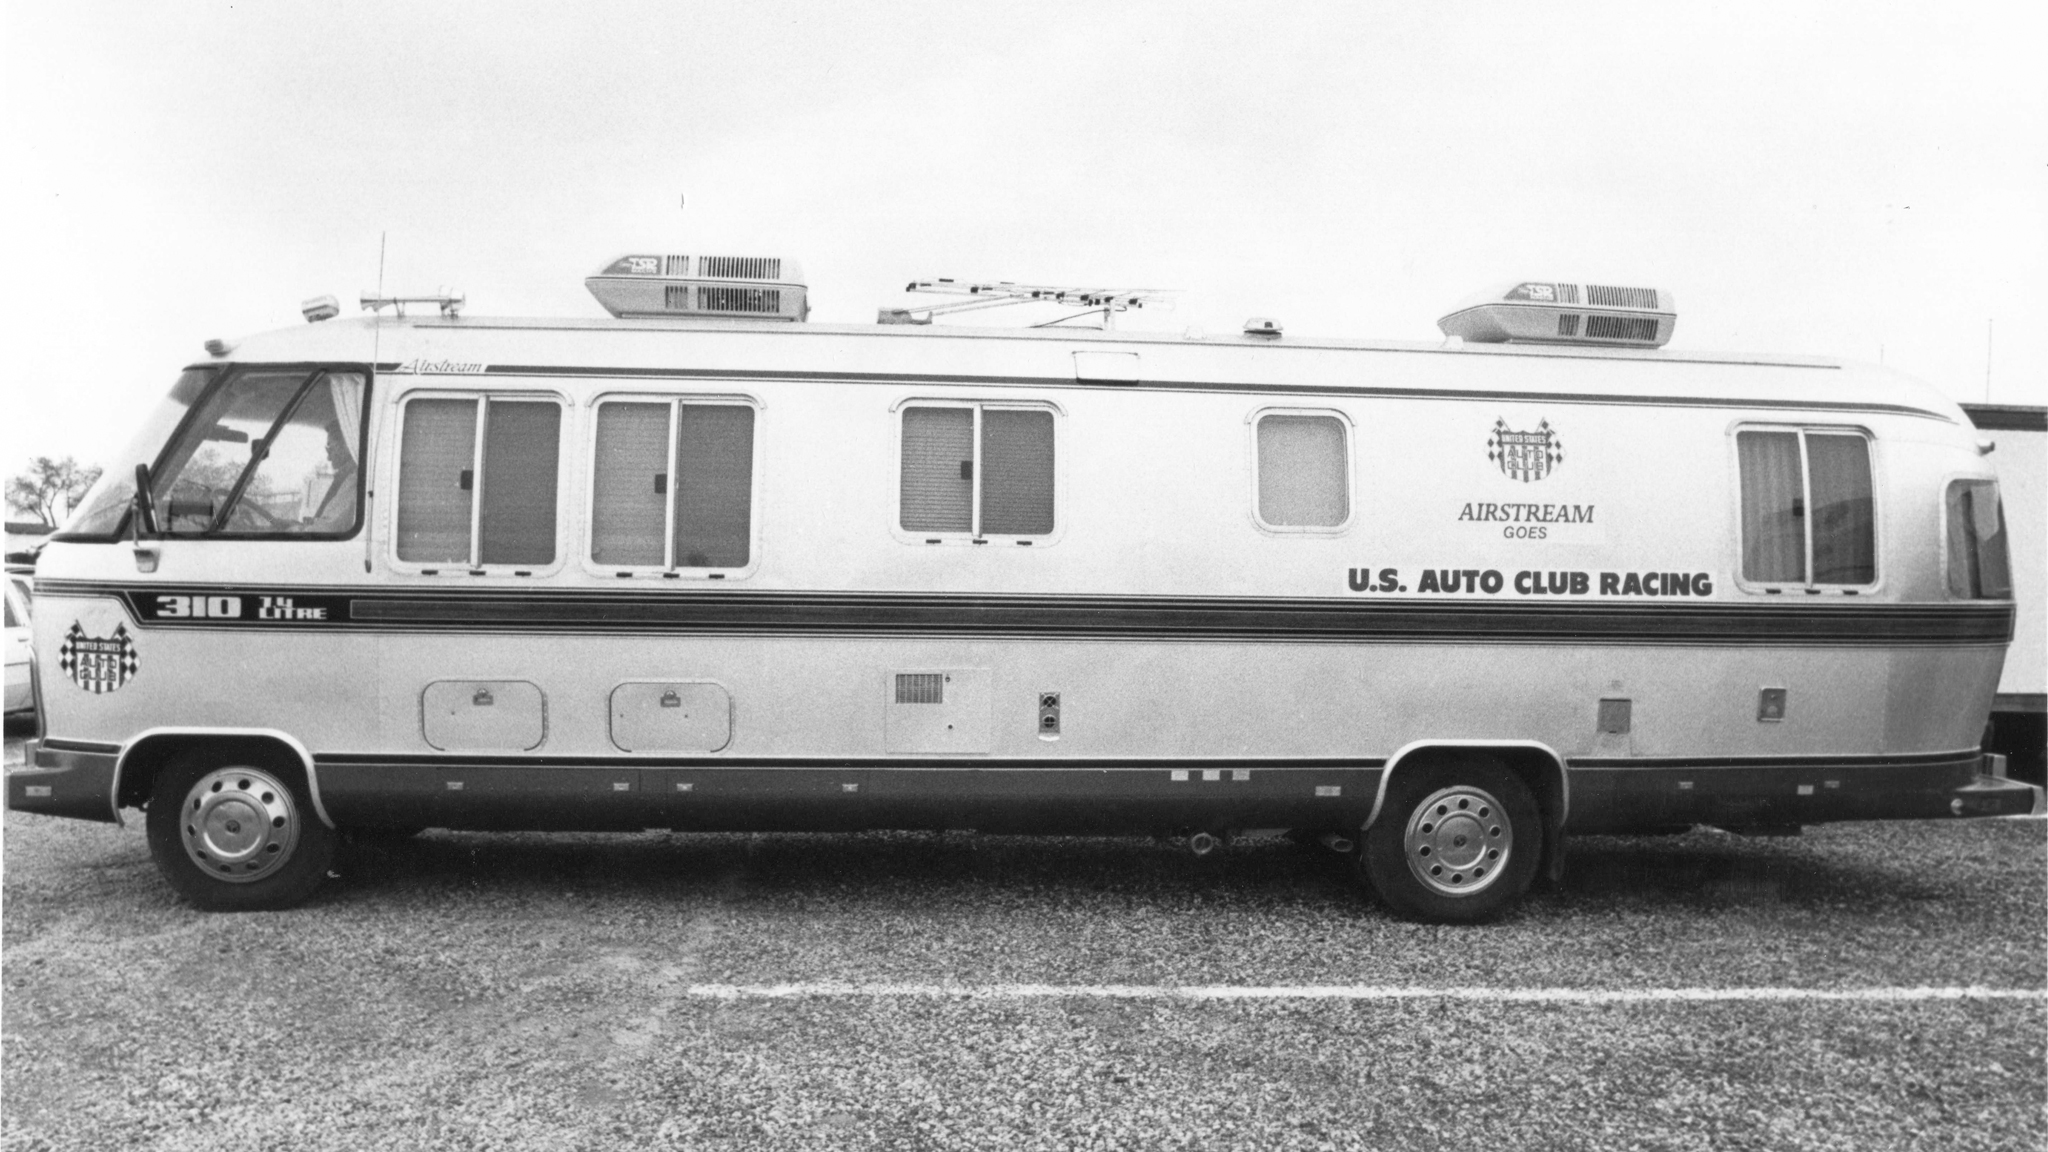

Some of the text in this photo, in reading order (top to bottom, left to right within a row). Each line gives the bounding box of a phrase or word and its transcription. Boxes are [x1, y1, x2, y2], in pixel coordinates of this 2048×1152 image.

[400, 358, 482, 375] Airstream
[1507, 449, 1543, 459] AUTO
[1507, 460, 1543, 471] CLUB
[1458, 502, 1595, 523] AIRSTREAM
[1503, 525, 1547, 539] GOES
[1348, 568, 1713, 597] U.S. AUTO CLUB RACING
[156, 596, 242, 618] 310
[259, 607, 327, 619] LITRE
[80, 656, 117, 668] AUTO
[80, 669, 117, 681] CLUB
